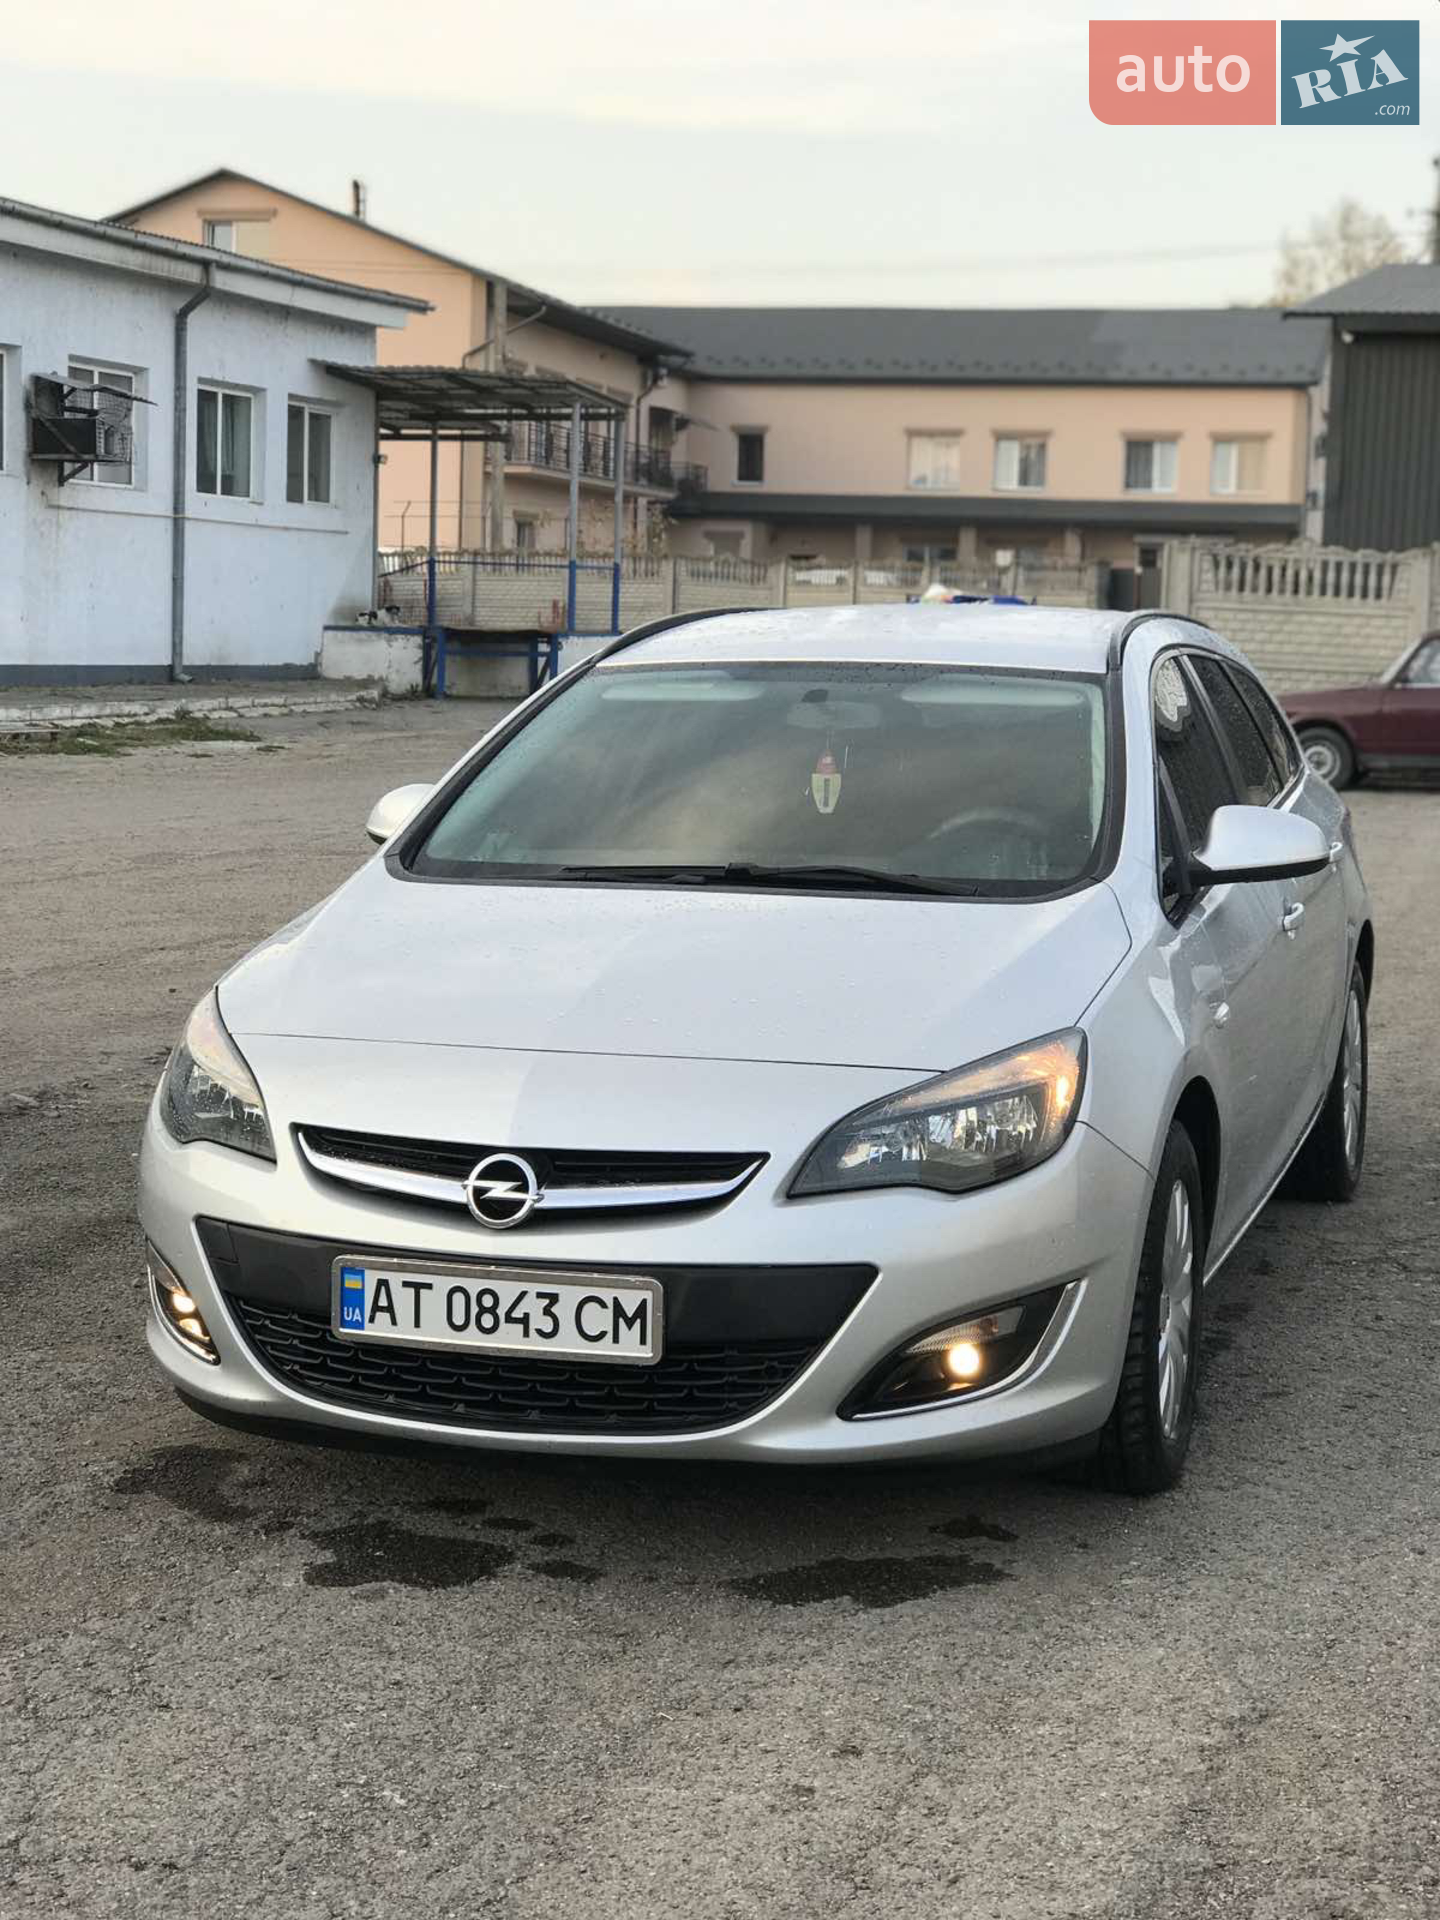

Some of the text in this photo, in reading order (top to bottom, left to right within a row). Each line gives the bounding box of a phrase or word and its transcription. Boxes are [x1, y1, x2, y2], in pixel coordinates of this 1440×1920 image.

[343, 1307, 362, 1323] UA
[368, 1278, 648, 1346] AT 0843 CM
